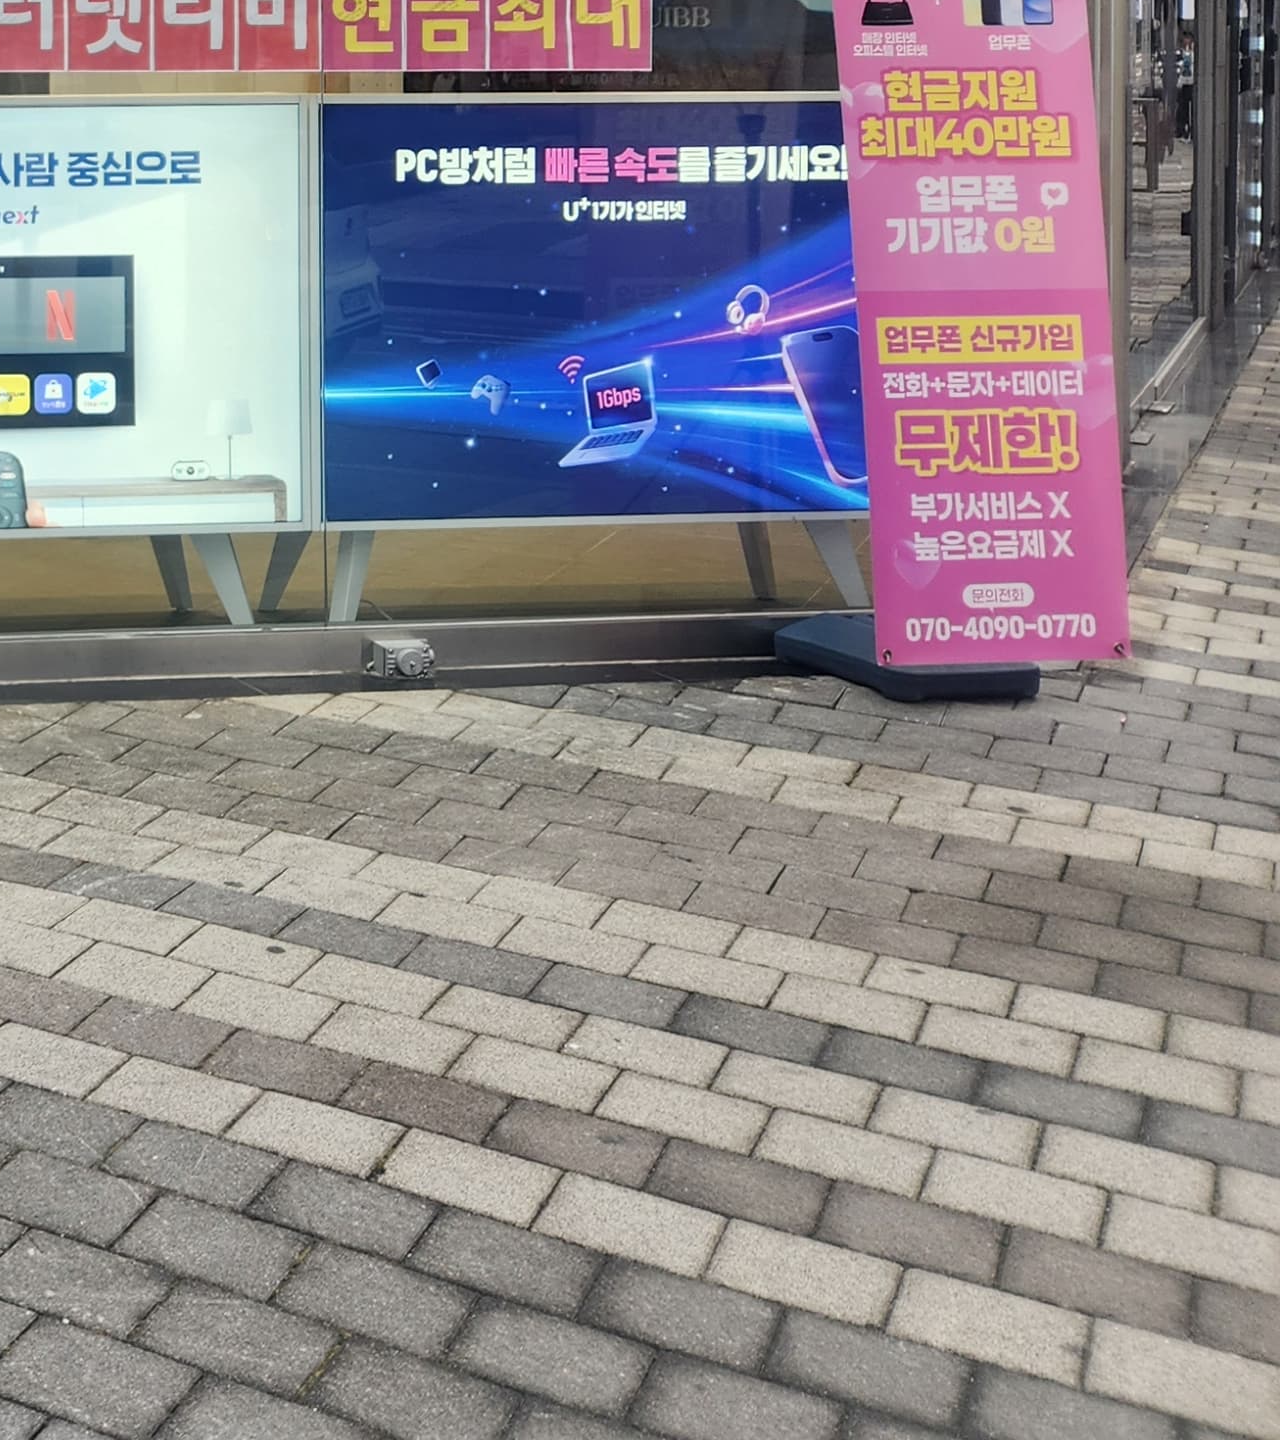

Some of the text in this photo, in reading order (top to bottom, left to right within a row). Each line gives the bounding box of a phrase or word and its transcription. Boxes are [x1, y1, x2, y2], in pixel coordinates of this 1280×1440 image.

[988, 35, 1032, 51] 업무폰
[882, 69, 1039, 112] 현금지원
[860, 114, 1074, 158] 최대40만원
[66, 149, 202, 187] 중심으로
[395, 146, 536, 185] PC방처럼
[544, 145, 610, 184] 빠른
[614, 145, 710, 185] 속도를
[916, 176, 1018, 213] 업무폰
[635, 200, 687, 223] 인터넷
[886, 215, 1057, 254] 기기값 0원
[884, 324, 1075, 355] 업무폰 신규가입
[596, 387, 642, 411] 1Gbps
[883, 369, 1085, 400] 전화+문자+데이터
[896, 407, 1081, 476] 무제한!
[910, 491, 1072, 523] 부가서비스 X
[913, 529, 1075, 561] 높은요금제 X
[971, 587, 1026, 605] 문의전화
[905, 614, 1097, 643] 070-4090-0770
